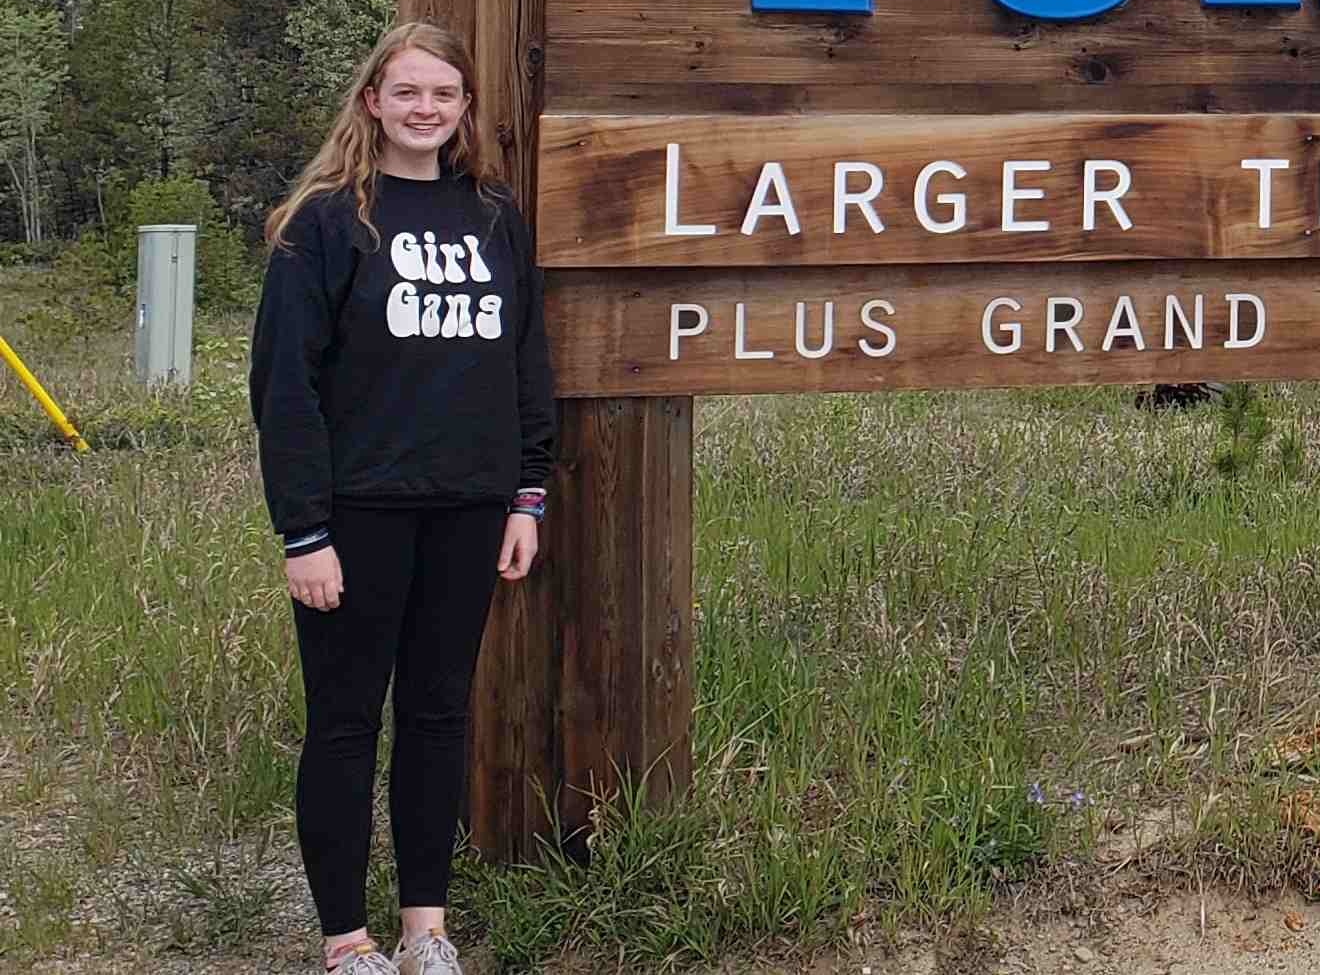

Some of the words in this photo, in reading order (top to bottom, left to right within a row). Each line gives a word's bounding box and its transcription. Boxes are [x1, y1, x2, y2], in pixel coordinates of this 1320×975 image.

[663, 142, 1133, 237] LARGER
[390, 231, 492, 285] Girl
[669, 299, 898, 361] PLUS
[981, 293, 1266, 354] GRAND
